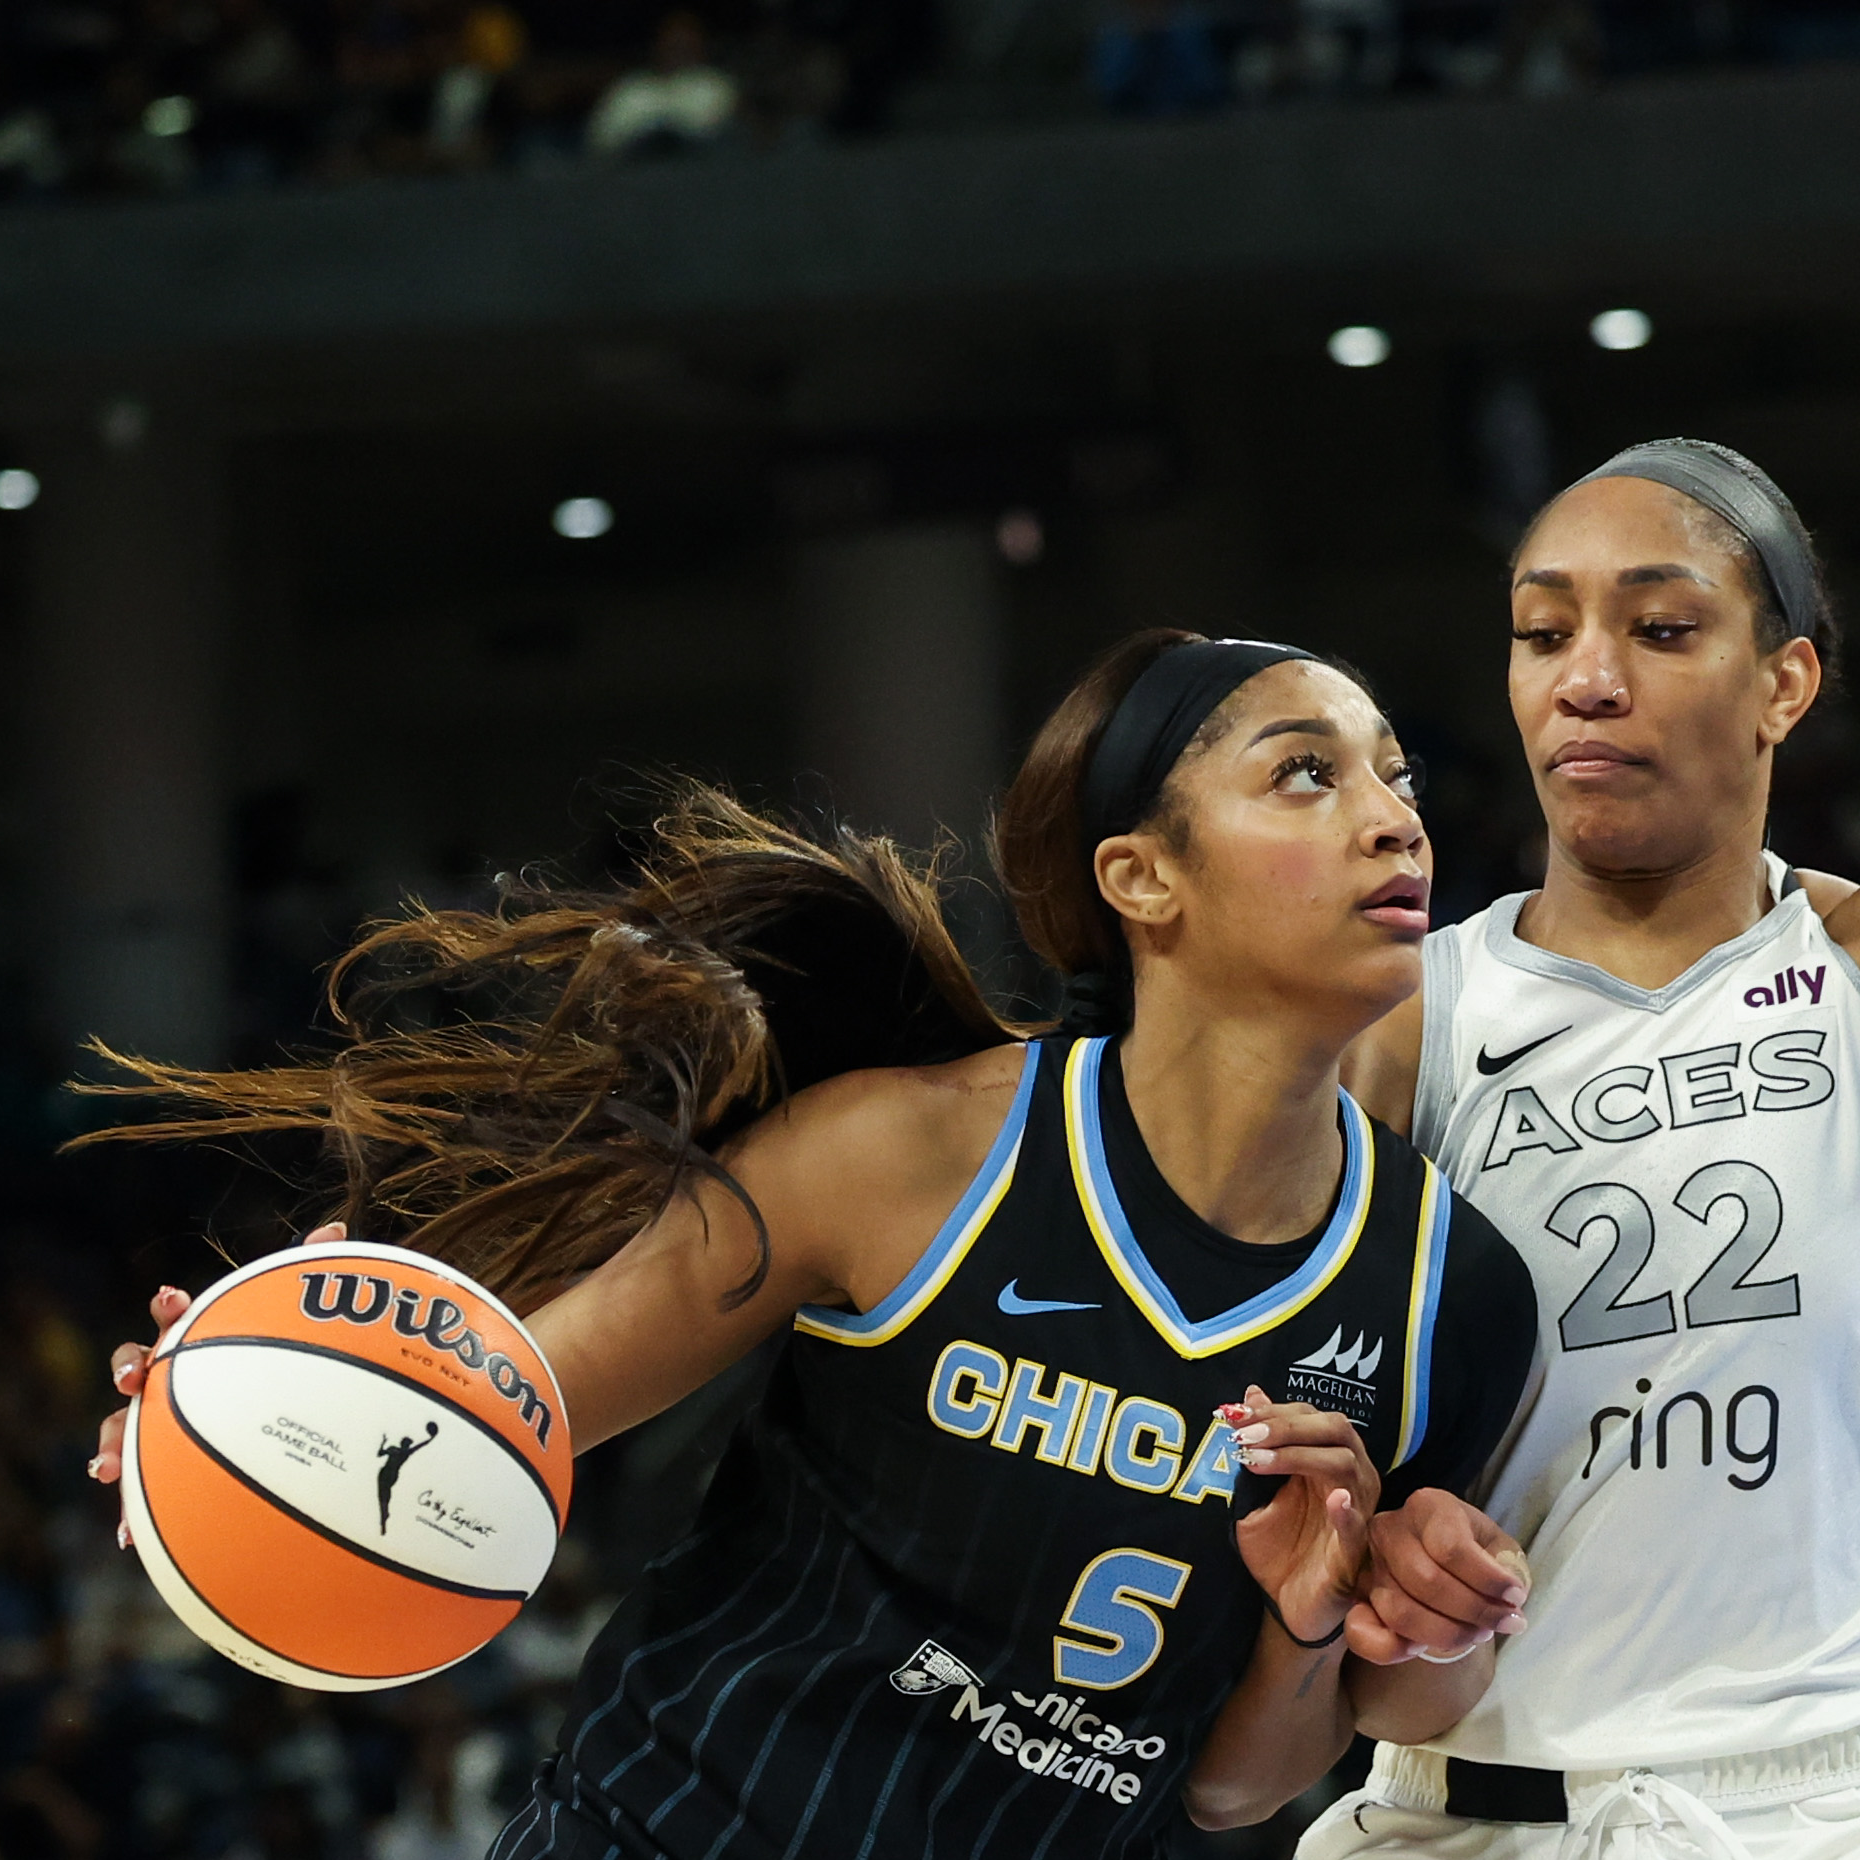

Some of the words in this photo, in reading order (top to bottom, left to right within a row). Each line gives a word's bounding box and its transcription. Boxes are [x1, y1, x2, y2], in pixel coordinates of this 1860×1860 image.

[1742, 964, 1828, 1009] ally
[1480, 1029, 1836, 1173] ACES
[1544, 1159, 1801, 1352] 22
[297, 1271, 553, 1453] Wilson
[1287, 1373, 1376, 1407] MAGELLAN
[261, 1424, 307, 1452] GAME
[308, 1446, 348, 1473] BALL
[276, 1416, 345, 1455] OFFICIAL
[1581, 1376, 1782, 1492] ring
[1052, 1547, 1193, 1691] 5
[949, 1683, 1142, 1805] Medicine
